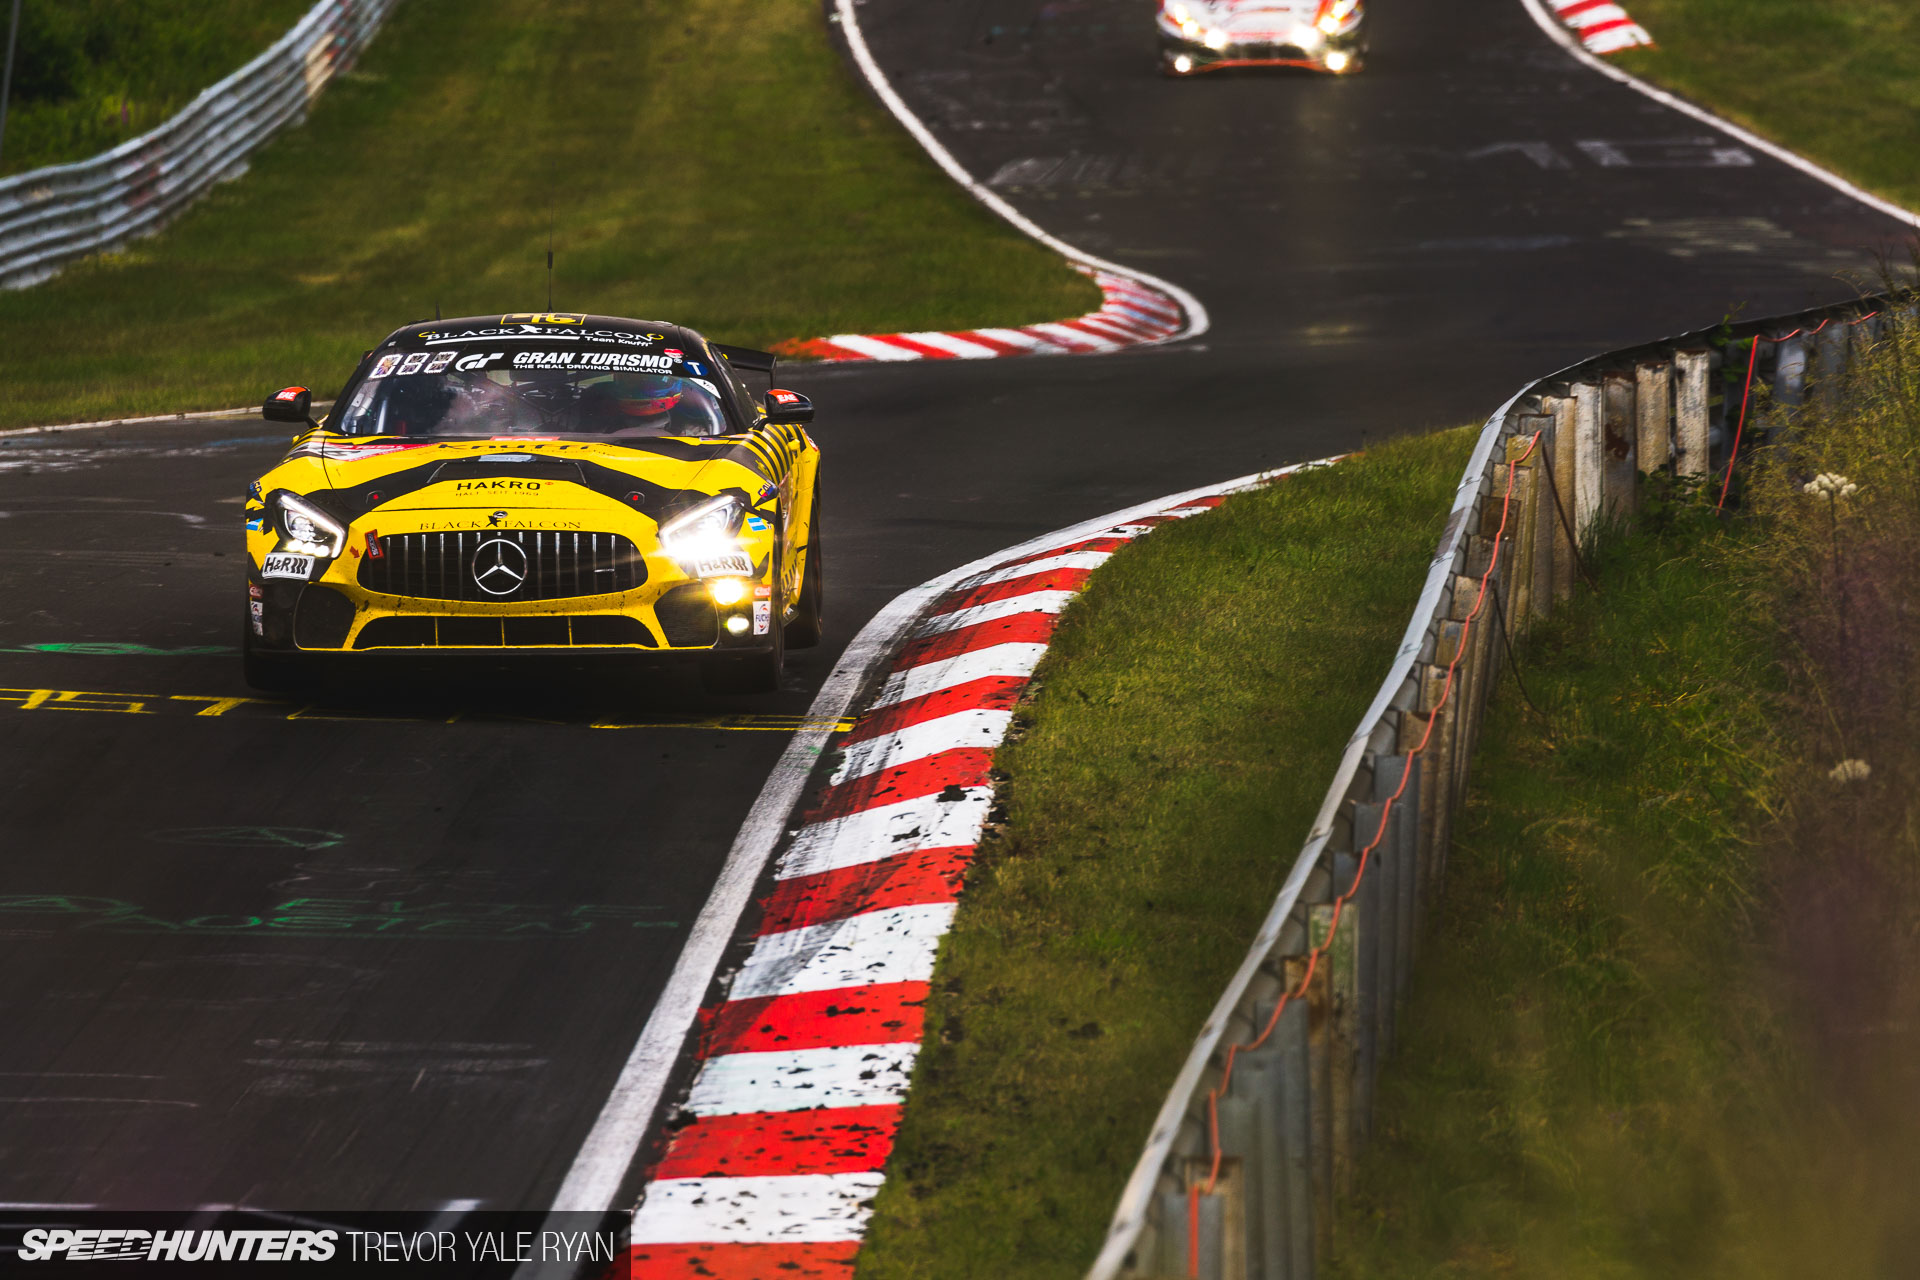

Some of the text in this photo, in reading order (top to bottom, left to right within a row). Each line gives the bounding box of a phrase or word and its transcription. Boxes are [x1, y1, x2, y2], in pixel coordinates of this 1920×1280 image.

[426, 326, 653, 342] BLACK FALCON
[584, 335, 615, 343] Team
[513, 352, 576, 364] GRAN
[613, 366, 673, 375] SIMULATOR
[278, 391, 296, 400] EAE
[777, 394, 798, 403] EAE
[456, 480, 541, 491] HAKRO
[420, 520, 581, 530] BLACK FALCON
